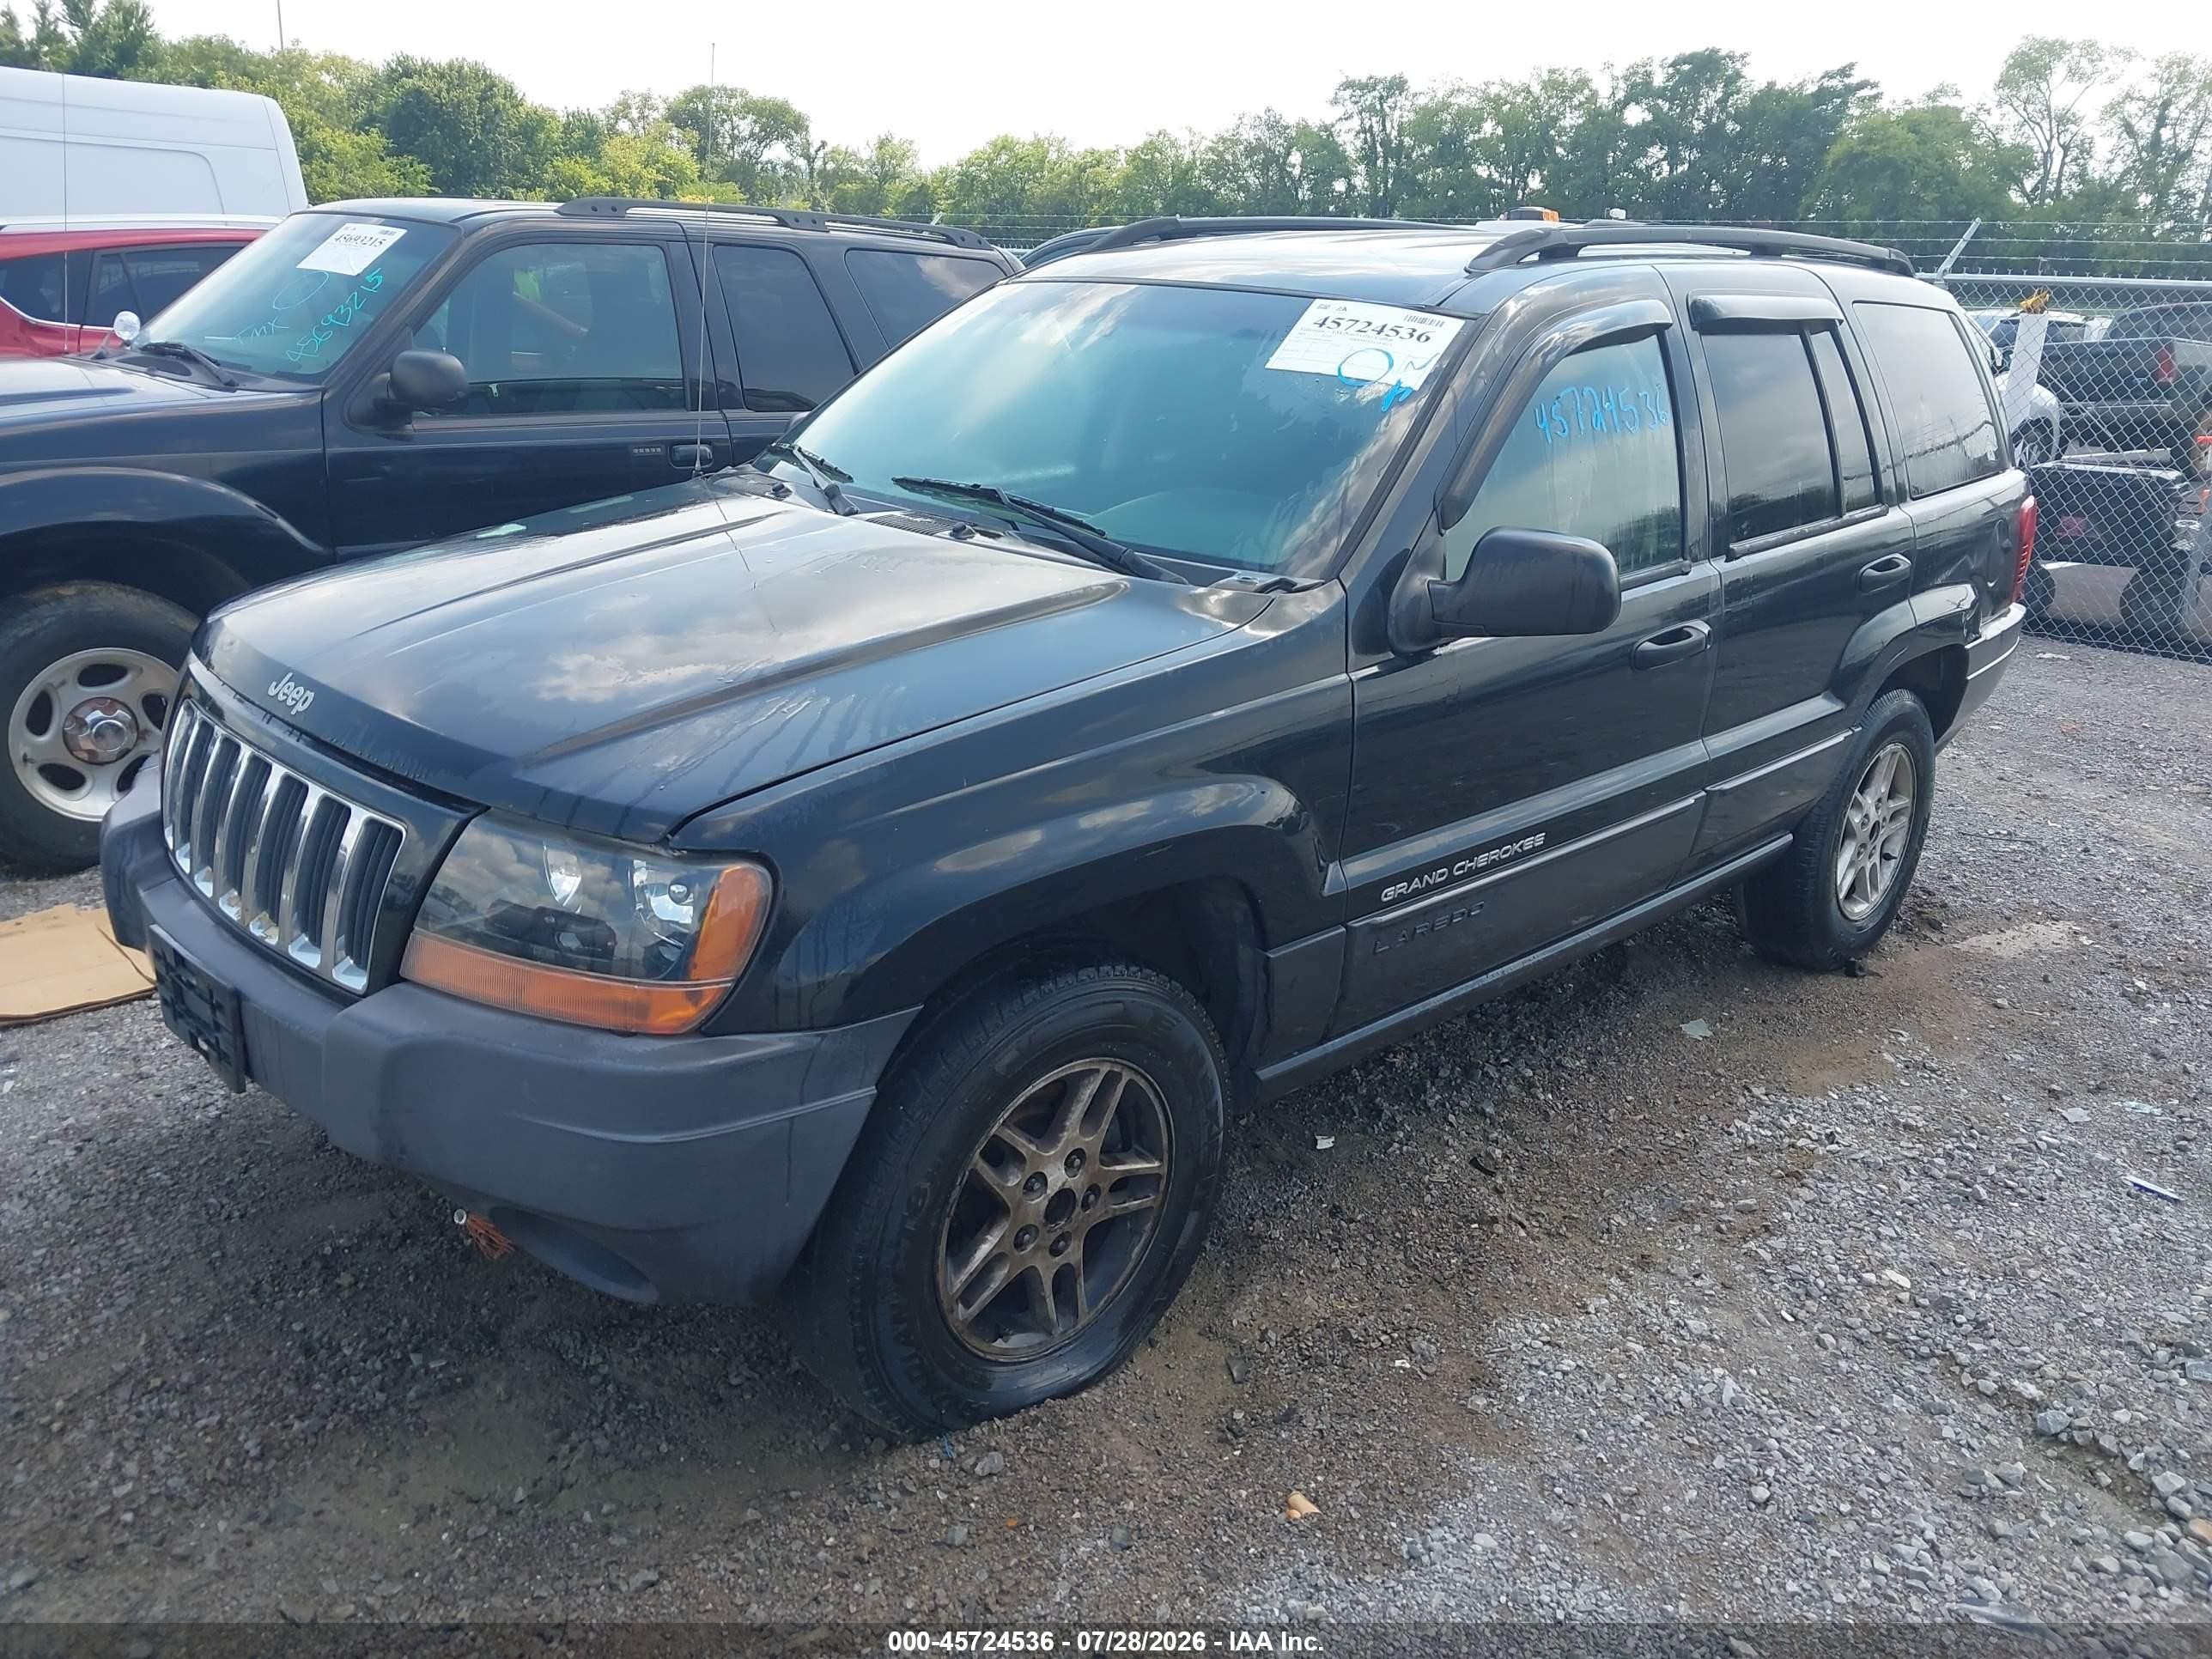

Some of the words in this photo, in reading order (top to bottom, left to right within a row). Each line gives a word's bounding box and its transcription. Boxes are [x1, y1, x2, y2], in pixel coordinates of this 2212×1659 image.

[1312, 315, 1437, 343] 45724536
[1534, 383, 1671, 445] 45724536
[267, 672, 316, 716] Jeep
[1380, 866, 1449, 902] GRAND
[1452, 831, 1547, 876] CHEROKEE
[1373, 900, 1486, 956] LAREDO
